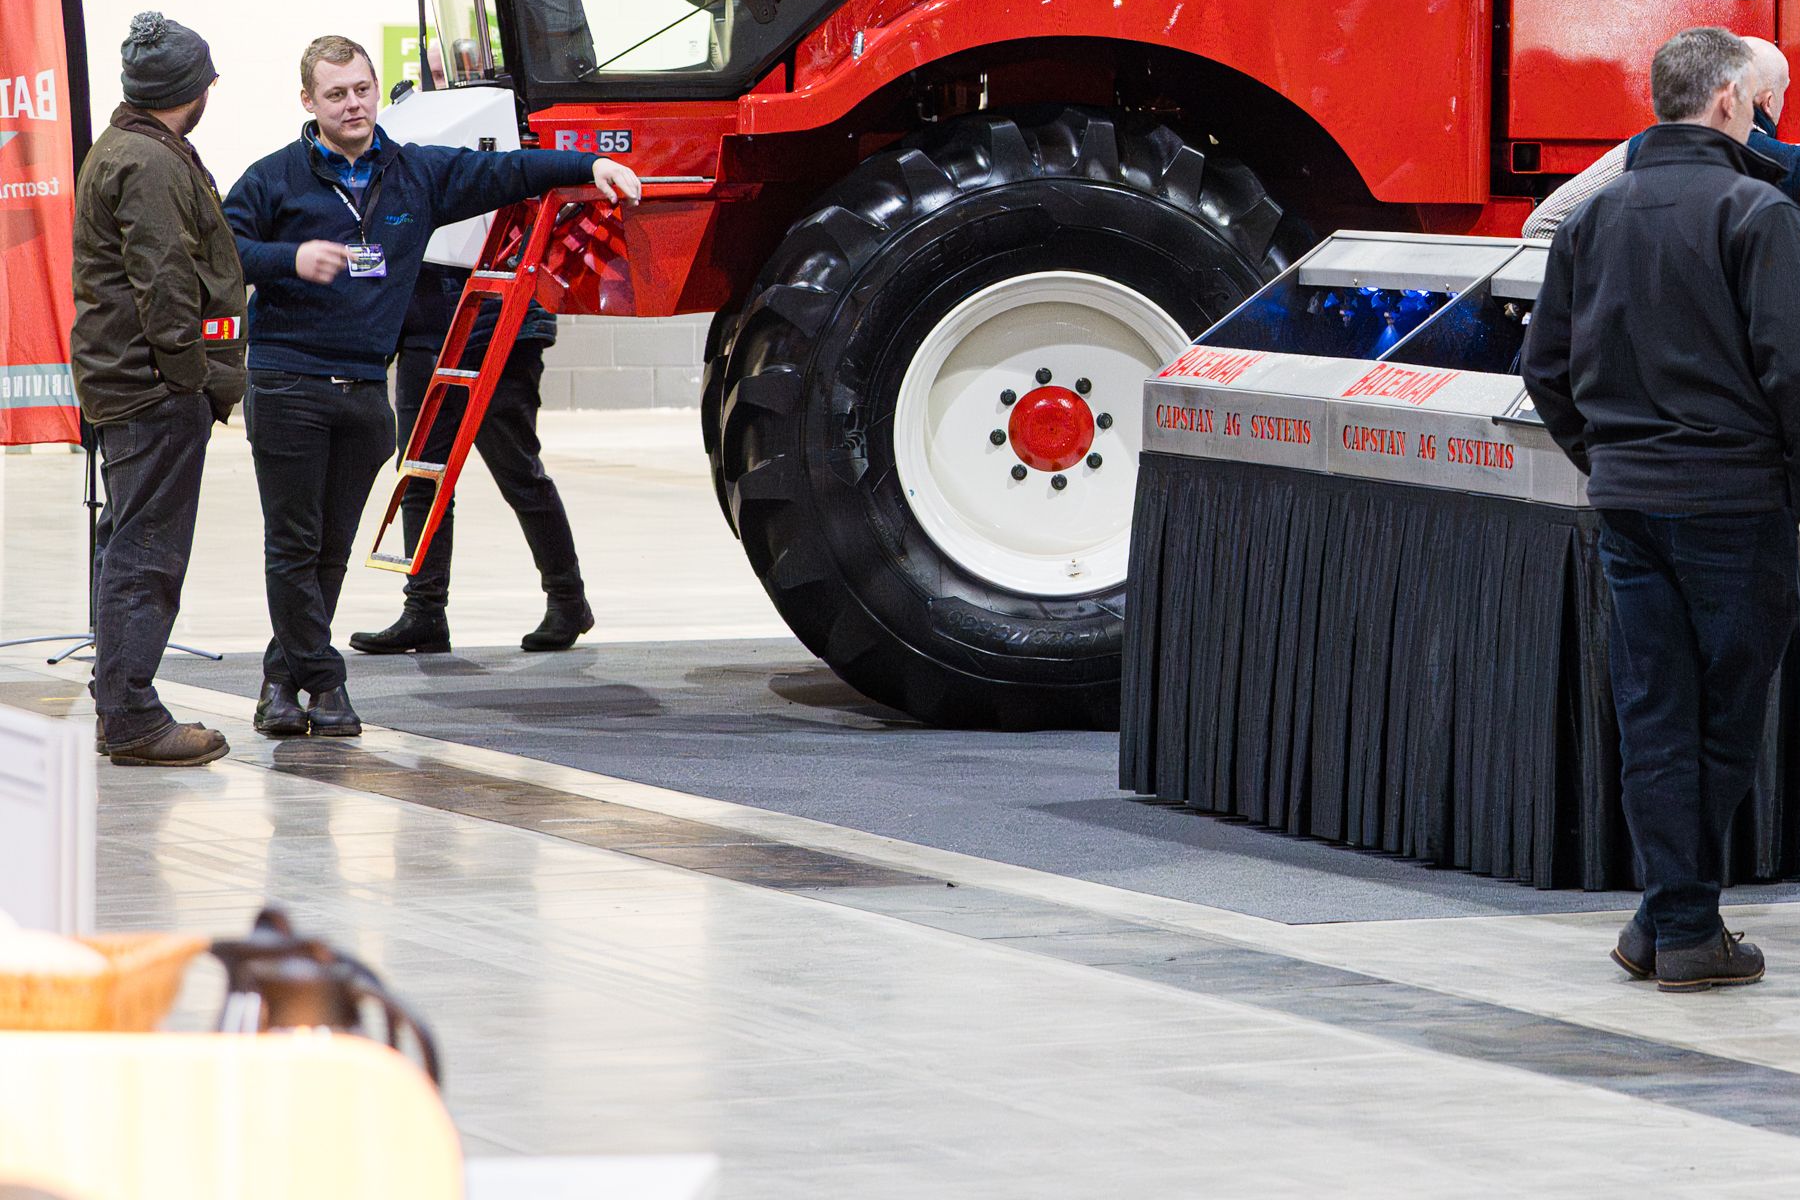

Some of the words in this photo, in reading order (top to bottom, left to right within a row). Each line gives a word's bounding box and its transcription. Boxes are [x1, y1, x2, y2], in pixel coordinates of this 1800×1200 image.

[1156, 345, 1270, 386] BATEMAN
[1340, 362, 1461, 407] BATEMAN
[1156, 404, 1214, 433] CAPSTAN
[1224, 412, 1241, 437] AG
[1251, 414, 1312, 446] SYSTEMS
[1342, 425, 1407, 457] CAPSTAN
[1417, 433, 1437, 461] AG
[1447, 436, 1515, 471] SYSTEMS
